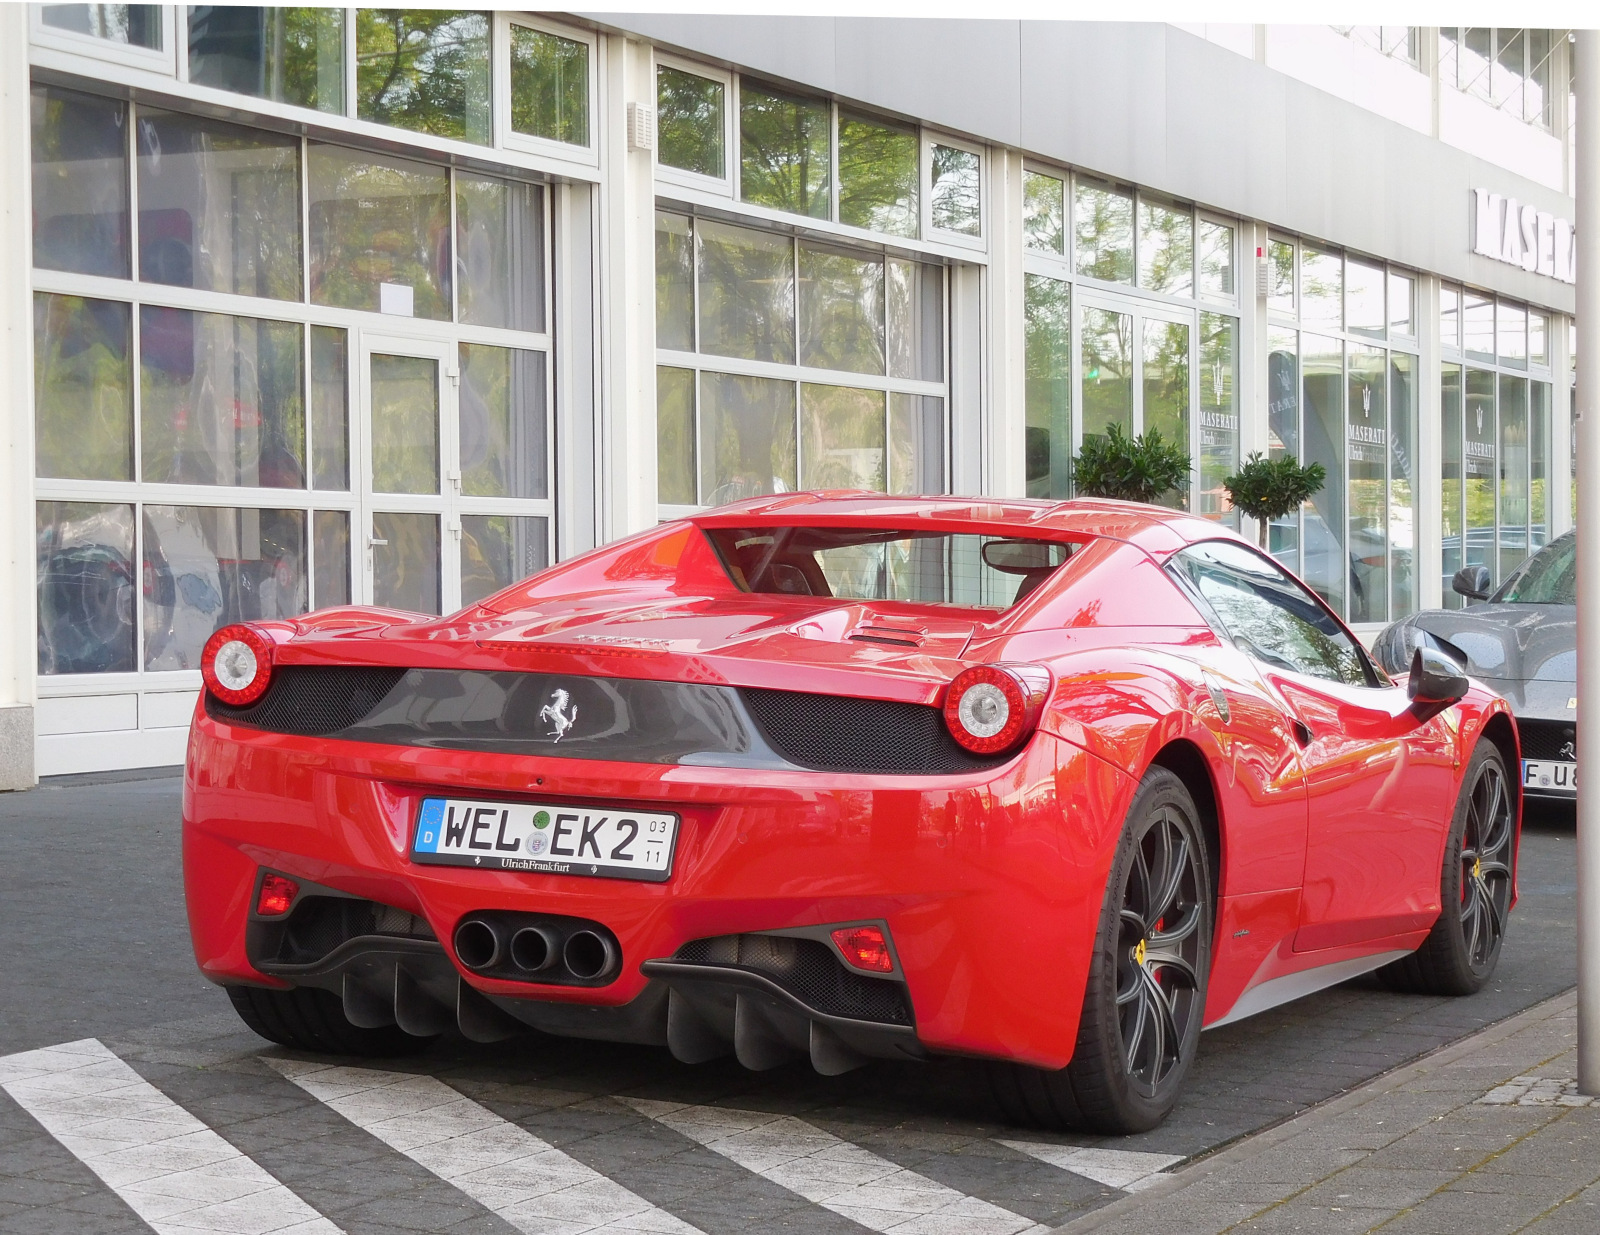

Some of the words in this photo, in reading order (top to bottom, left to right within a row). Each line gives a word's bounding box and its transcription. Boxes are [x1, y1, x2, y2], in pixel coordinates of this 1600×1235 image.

[1200, 411, 1238, 430] MASERATI
[1349, 424, 1386, 444] MASERATI
[1465, 441, 1495, 458] MASERATI
[1526, 764, 1539, 784] F
[445, 806, 521, 852] WEL
[650, 820, 667, 833] 03
[424, 831, 433, 844] D
[501, 858, 570, 872] UlrichFrankfurt
[645, 850, 661, 863] 11
